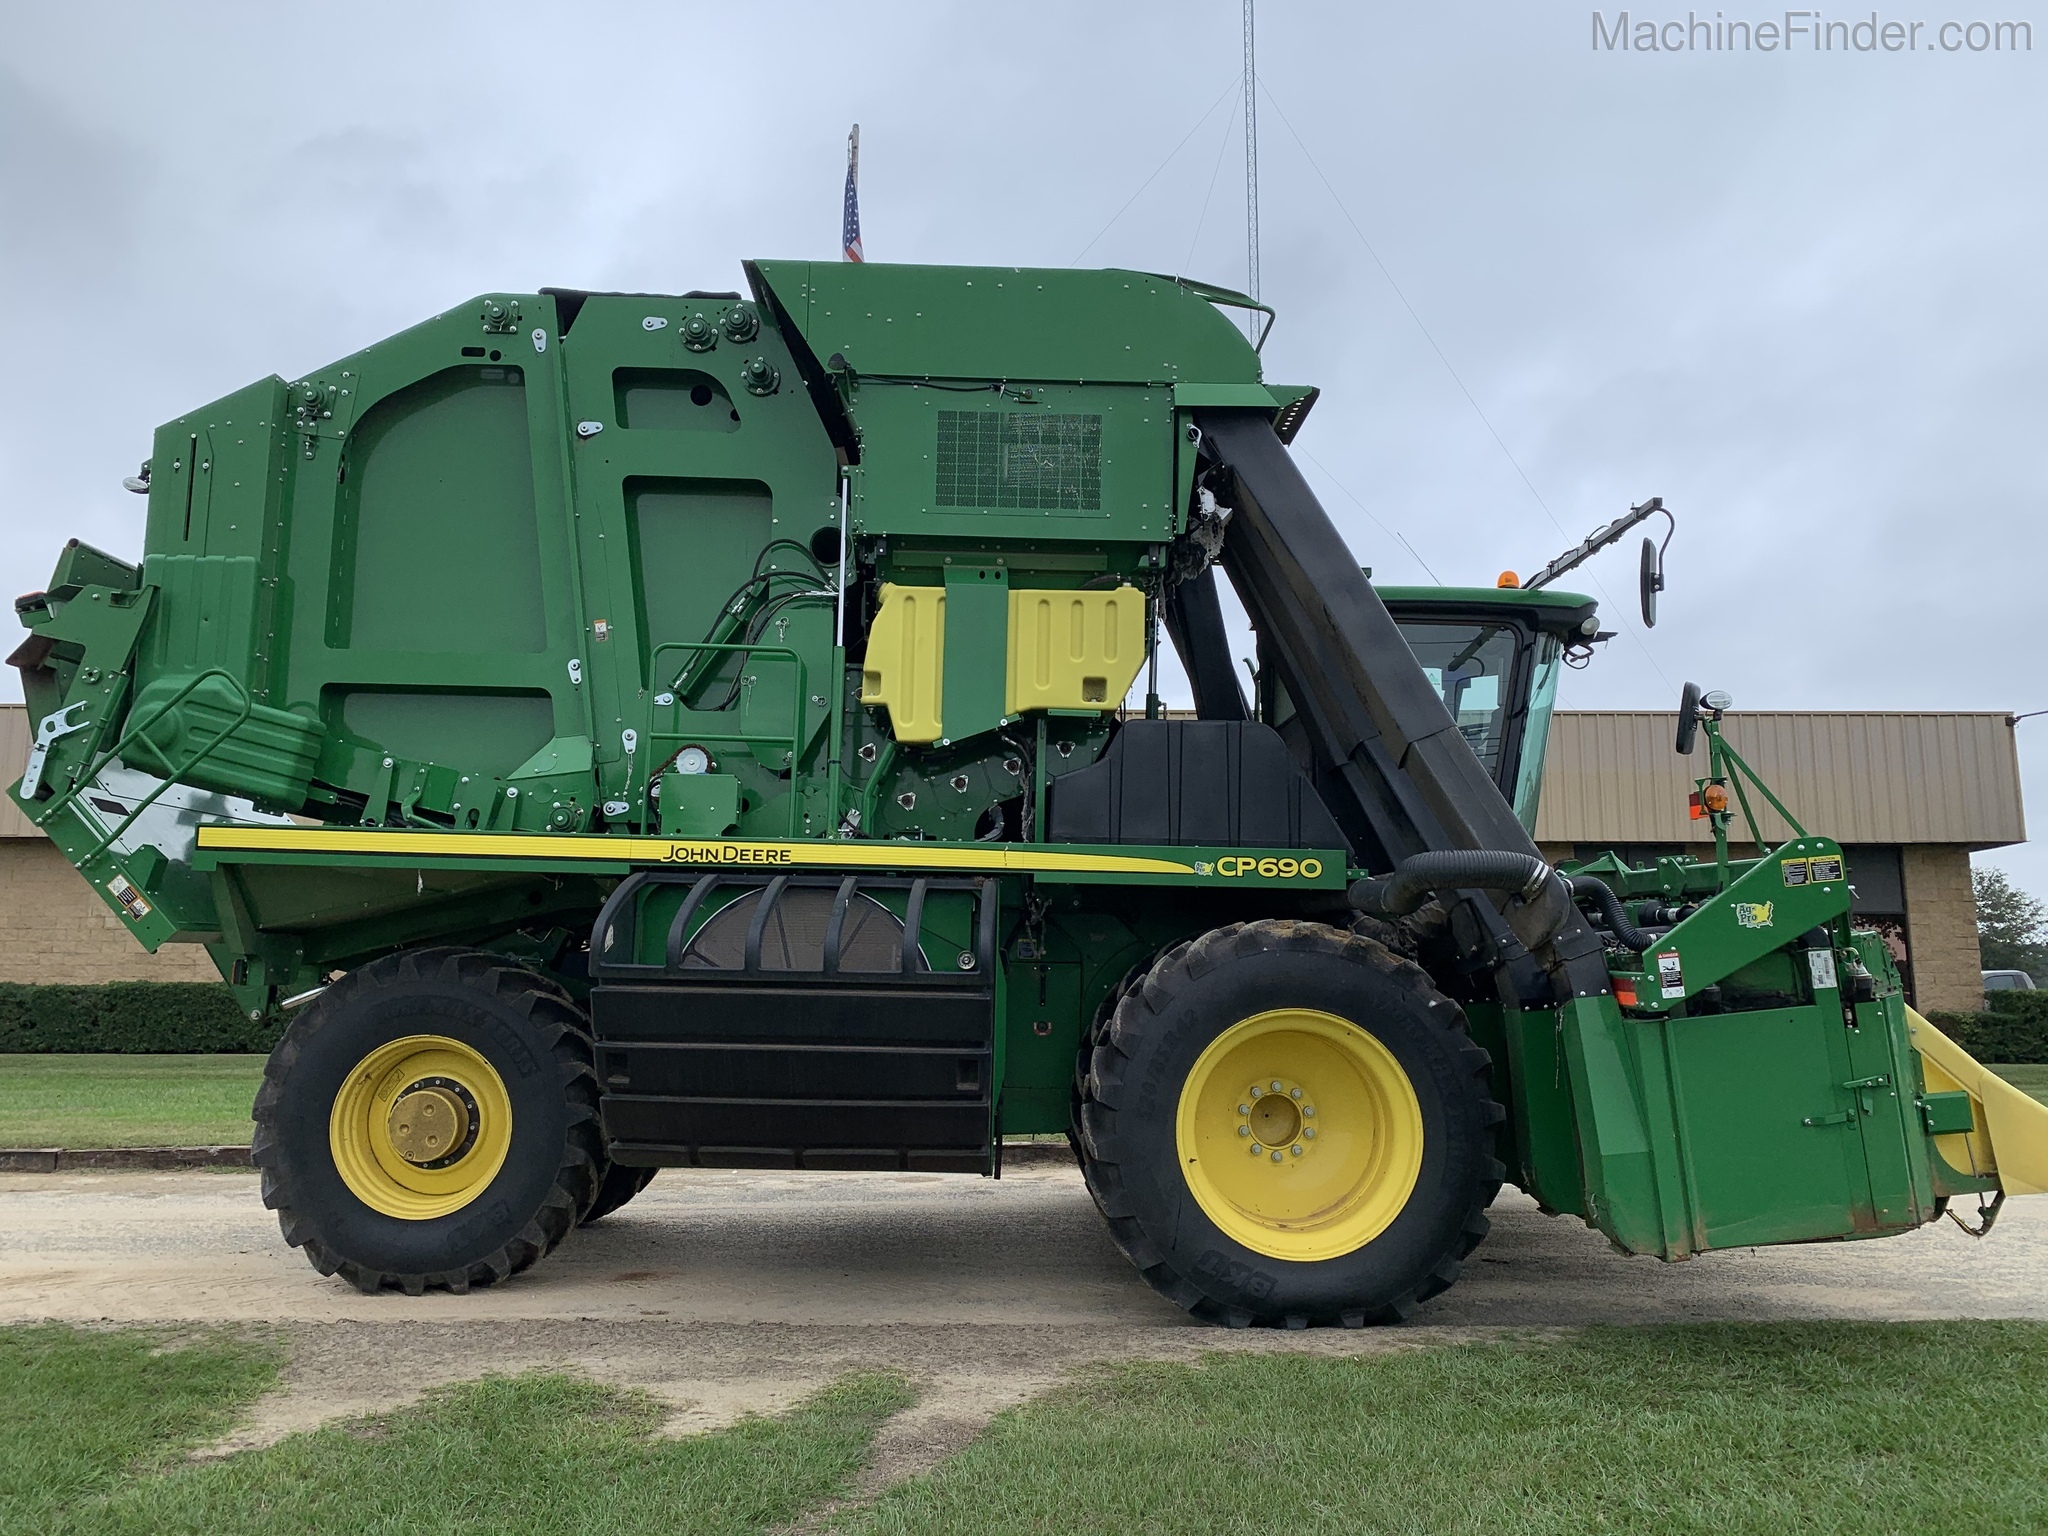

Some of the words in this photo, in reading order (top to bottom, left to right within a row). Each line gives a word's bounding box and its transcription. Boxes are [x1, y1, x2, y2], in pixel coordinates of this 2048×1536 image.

[663, 845, 719, 861] JOHN
[723, 846, 791, 862] DEERE
[1216, 856, 1323, 879] CP690
